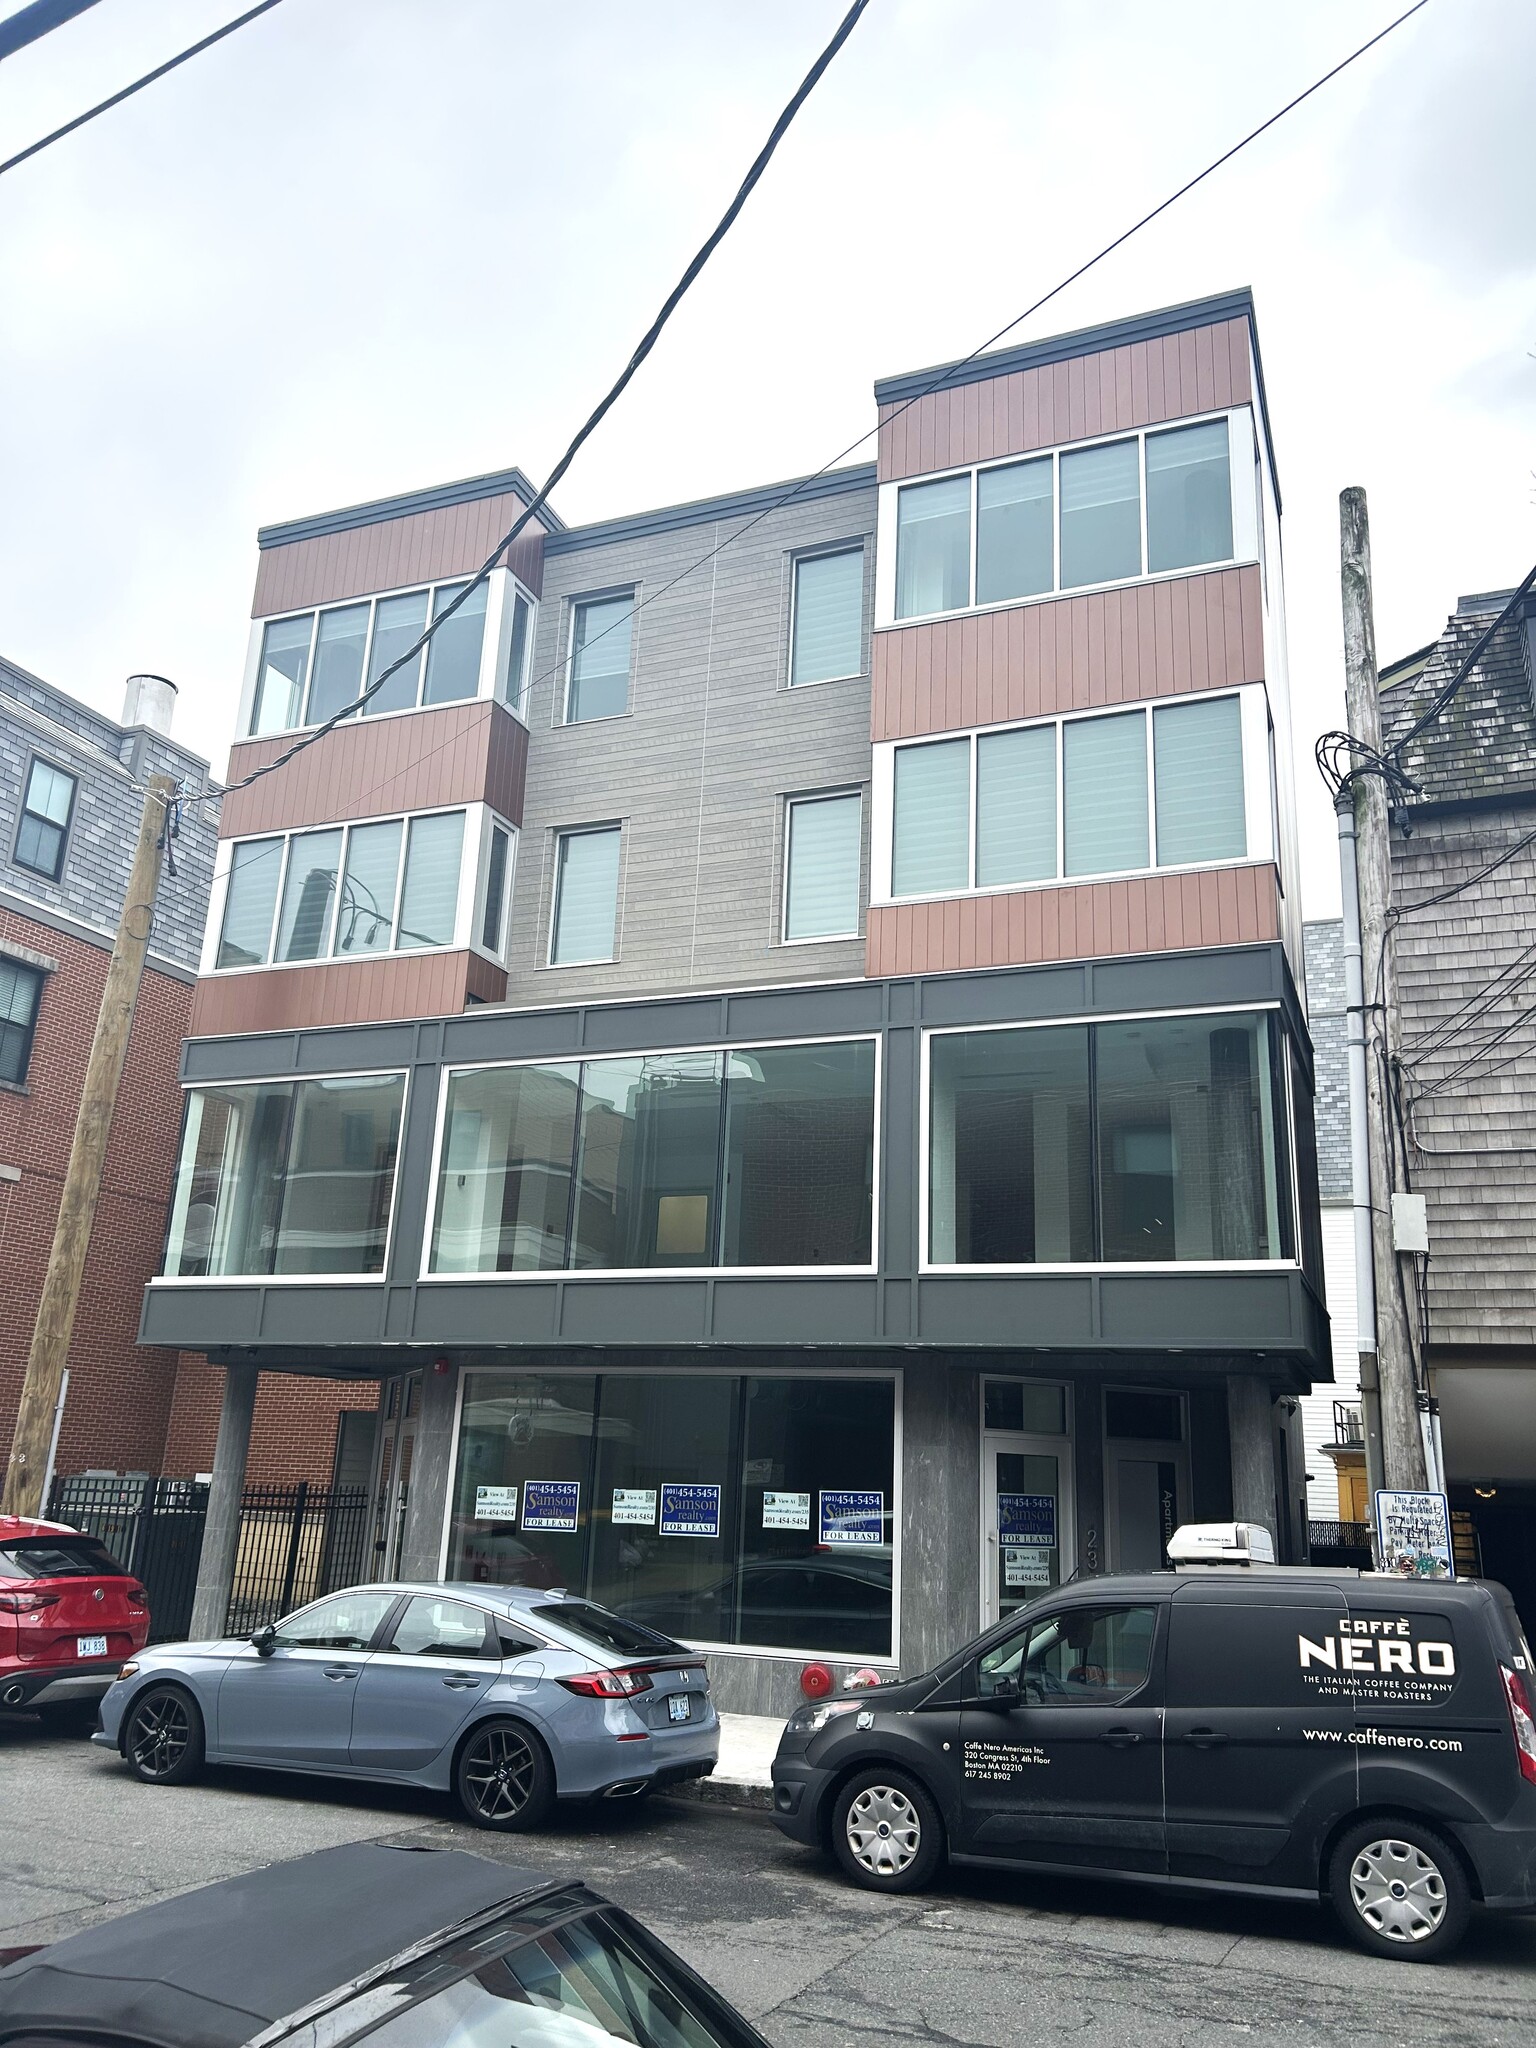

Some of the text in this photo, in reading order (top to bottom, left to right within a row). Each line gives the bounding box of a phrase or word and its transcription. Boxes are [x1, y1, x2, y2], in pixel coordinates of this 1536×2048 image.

[526, 1492, 576, 1510] Samson
[664, 1496, 716, 1514] Samson
[1394, 1495, 1430, 1505] This Block
[476, 1508, 514, 1516] 401-454-5454
[823, 1503, 879, 1522] Samson
[1392, 1504, 1432, 1515] Is Regulated
[614, 1512, 654, 1520] 401-454-5454
[764, 1516, 808, 1525] 401-454-5454
[1001, 1506, 1052, 1525] Samson
[526, 1518, 573, 1527] FOR LEASE
[664, 1522, 714, 1532] FOR LEASE
[1162, 1490, 1174, 1566] Apartms
[824, 1532, 878, 1541] FOR LEASE
[1002, 1534, 1052, 1543] FOR LEASE
[1391, 1538, 1402, 1548] Pay
[1006, 1574, 1049, 1582] 401-454-5454
[1339, 1618, 1410, 1636] CAFFÈ
[1298, 1634, 1456, 1676] NERO
[1303, 1675, 1453, 1692] THE ITALIAN COFFEE COMPANY
[1318, 1686, 1432, 1701] AND MASTER ROASTERS
[1302, 1728, 1463, 1752] www.caffenero.com
[964, 1742, 1044, 1754] Caffe Nero Americas Inc
[964, 1751, 978, 1759] 320
[980, 1752, 1009, 1762] Congress
[1010, 1755, 1019, 1763] St,
[1034, 1756, 1050, 1764] Floor
[964, 1761, 1023, 1772] Boston MA 02210
[964, 1770, 976, 1778] 617
[994, 1772, 1011, 1780] 8902
